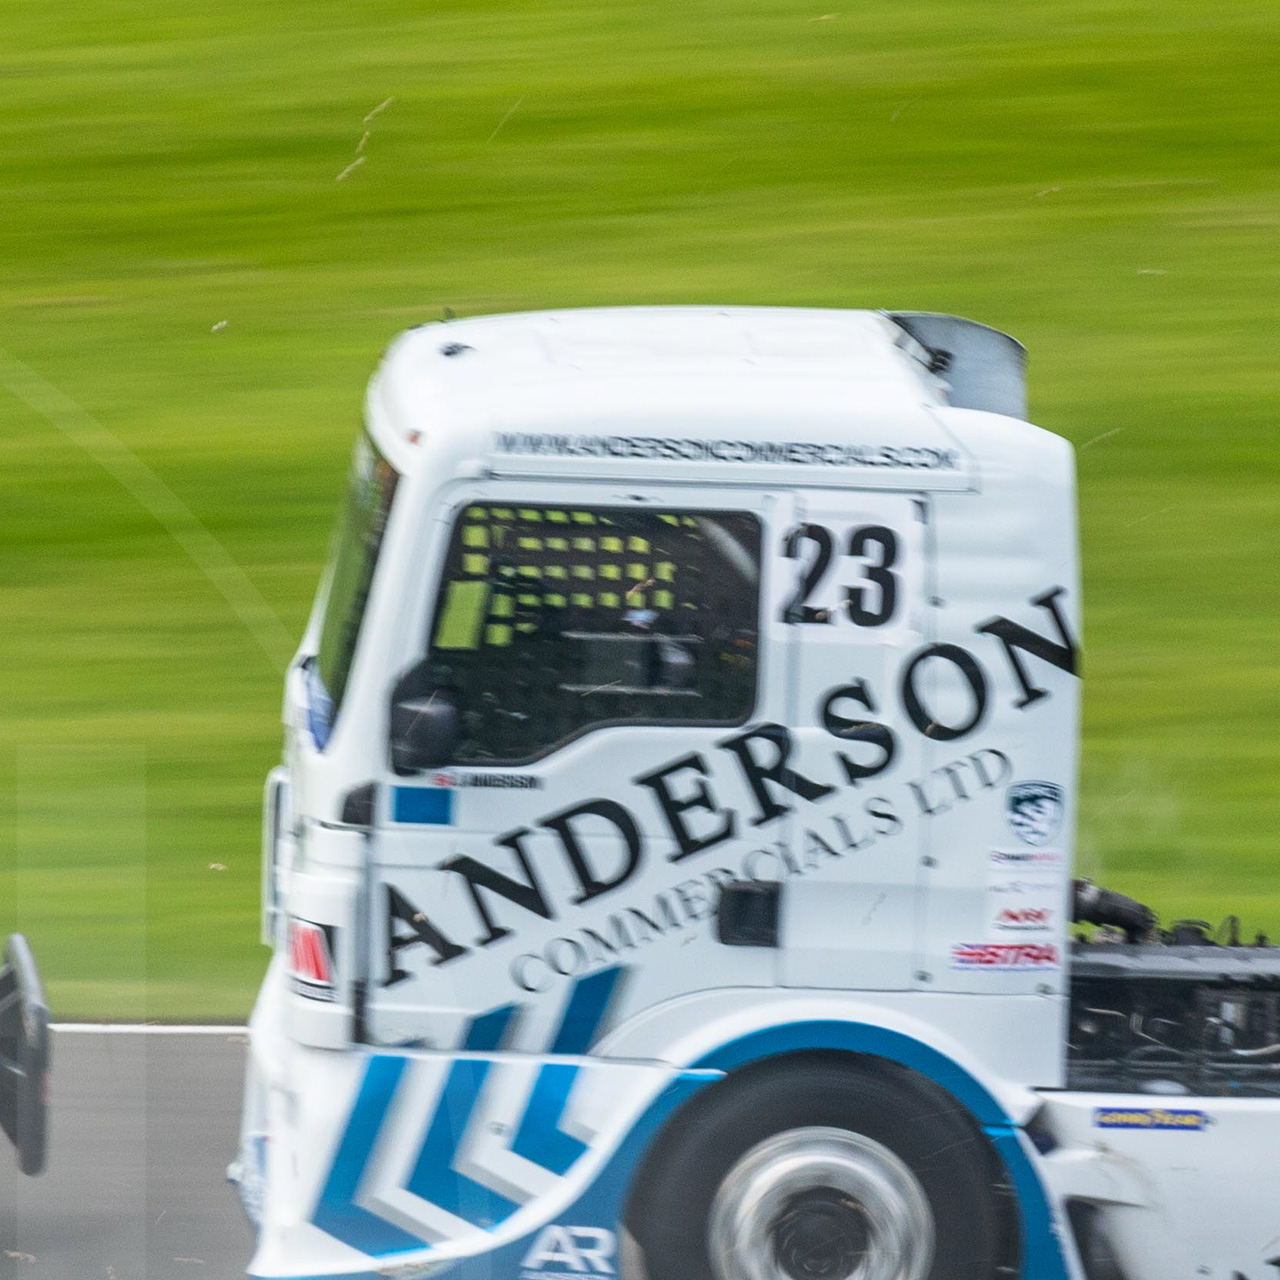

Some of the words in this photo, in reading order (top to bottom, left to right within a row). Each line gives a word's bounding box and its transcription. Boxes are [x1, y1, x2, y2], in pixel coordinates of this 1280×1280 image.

[782, 525, 900, 628] 23
[380, 585, 1082, 988] ANDERSON
[509, 796, 902, 993] COMMERCIALS
[906, 747, 1013, 816] LTD
[521, 1224, 616, 1274] AR
